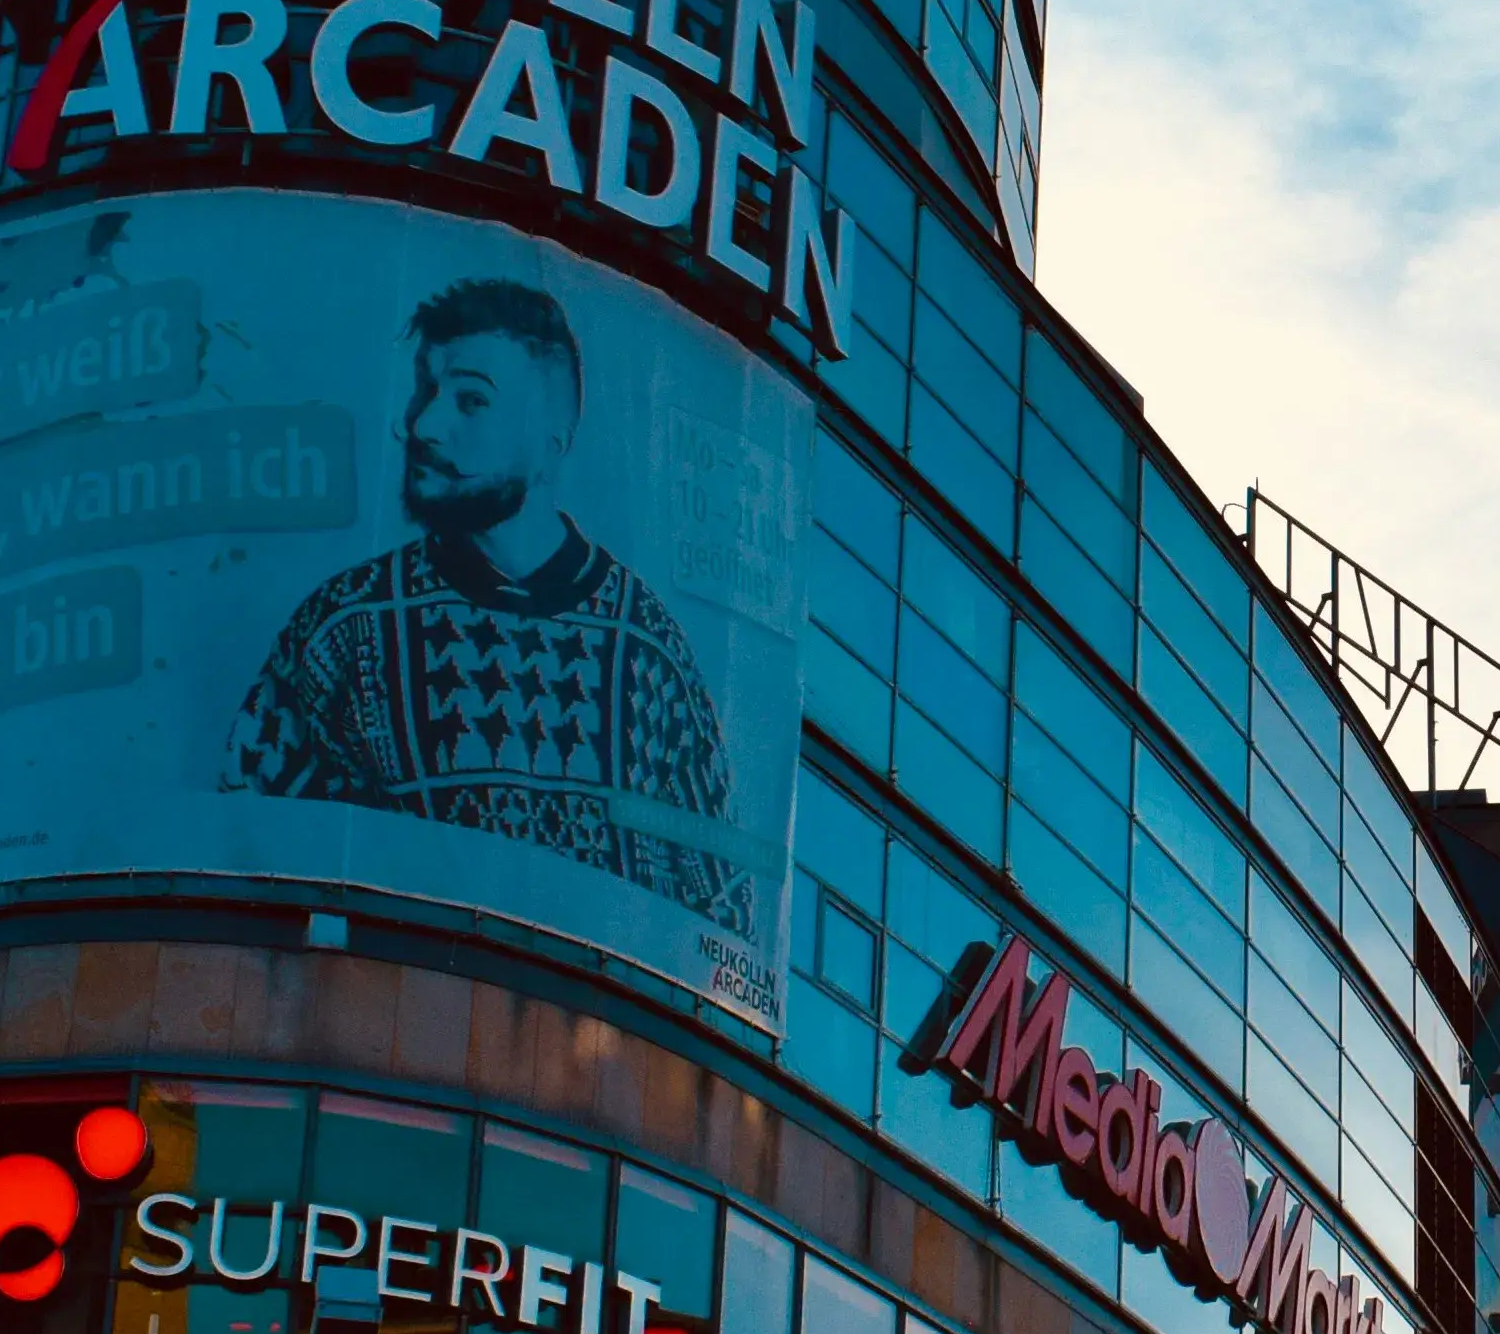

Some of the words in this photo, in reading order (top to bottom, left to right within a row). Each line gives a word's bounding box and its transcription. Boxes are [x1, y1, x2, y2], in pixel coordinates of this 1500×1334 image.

[16, 305, 173, 406] weiß
[21, 452, 203, 537] wann
[225, 427, 329, 501] ich
[12, 595, 115, 676] bin
[698, 933, 777, 995] NEUKÖLLN
[712, 968, 780, 1022] ARCADEN
